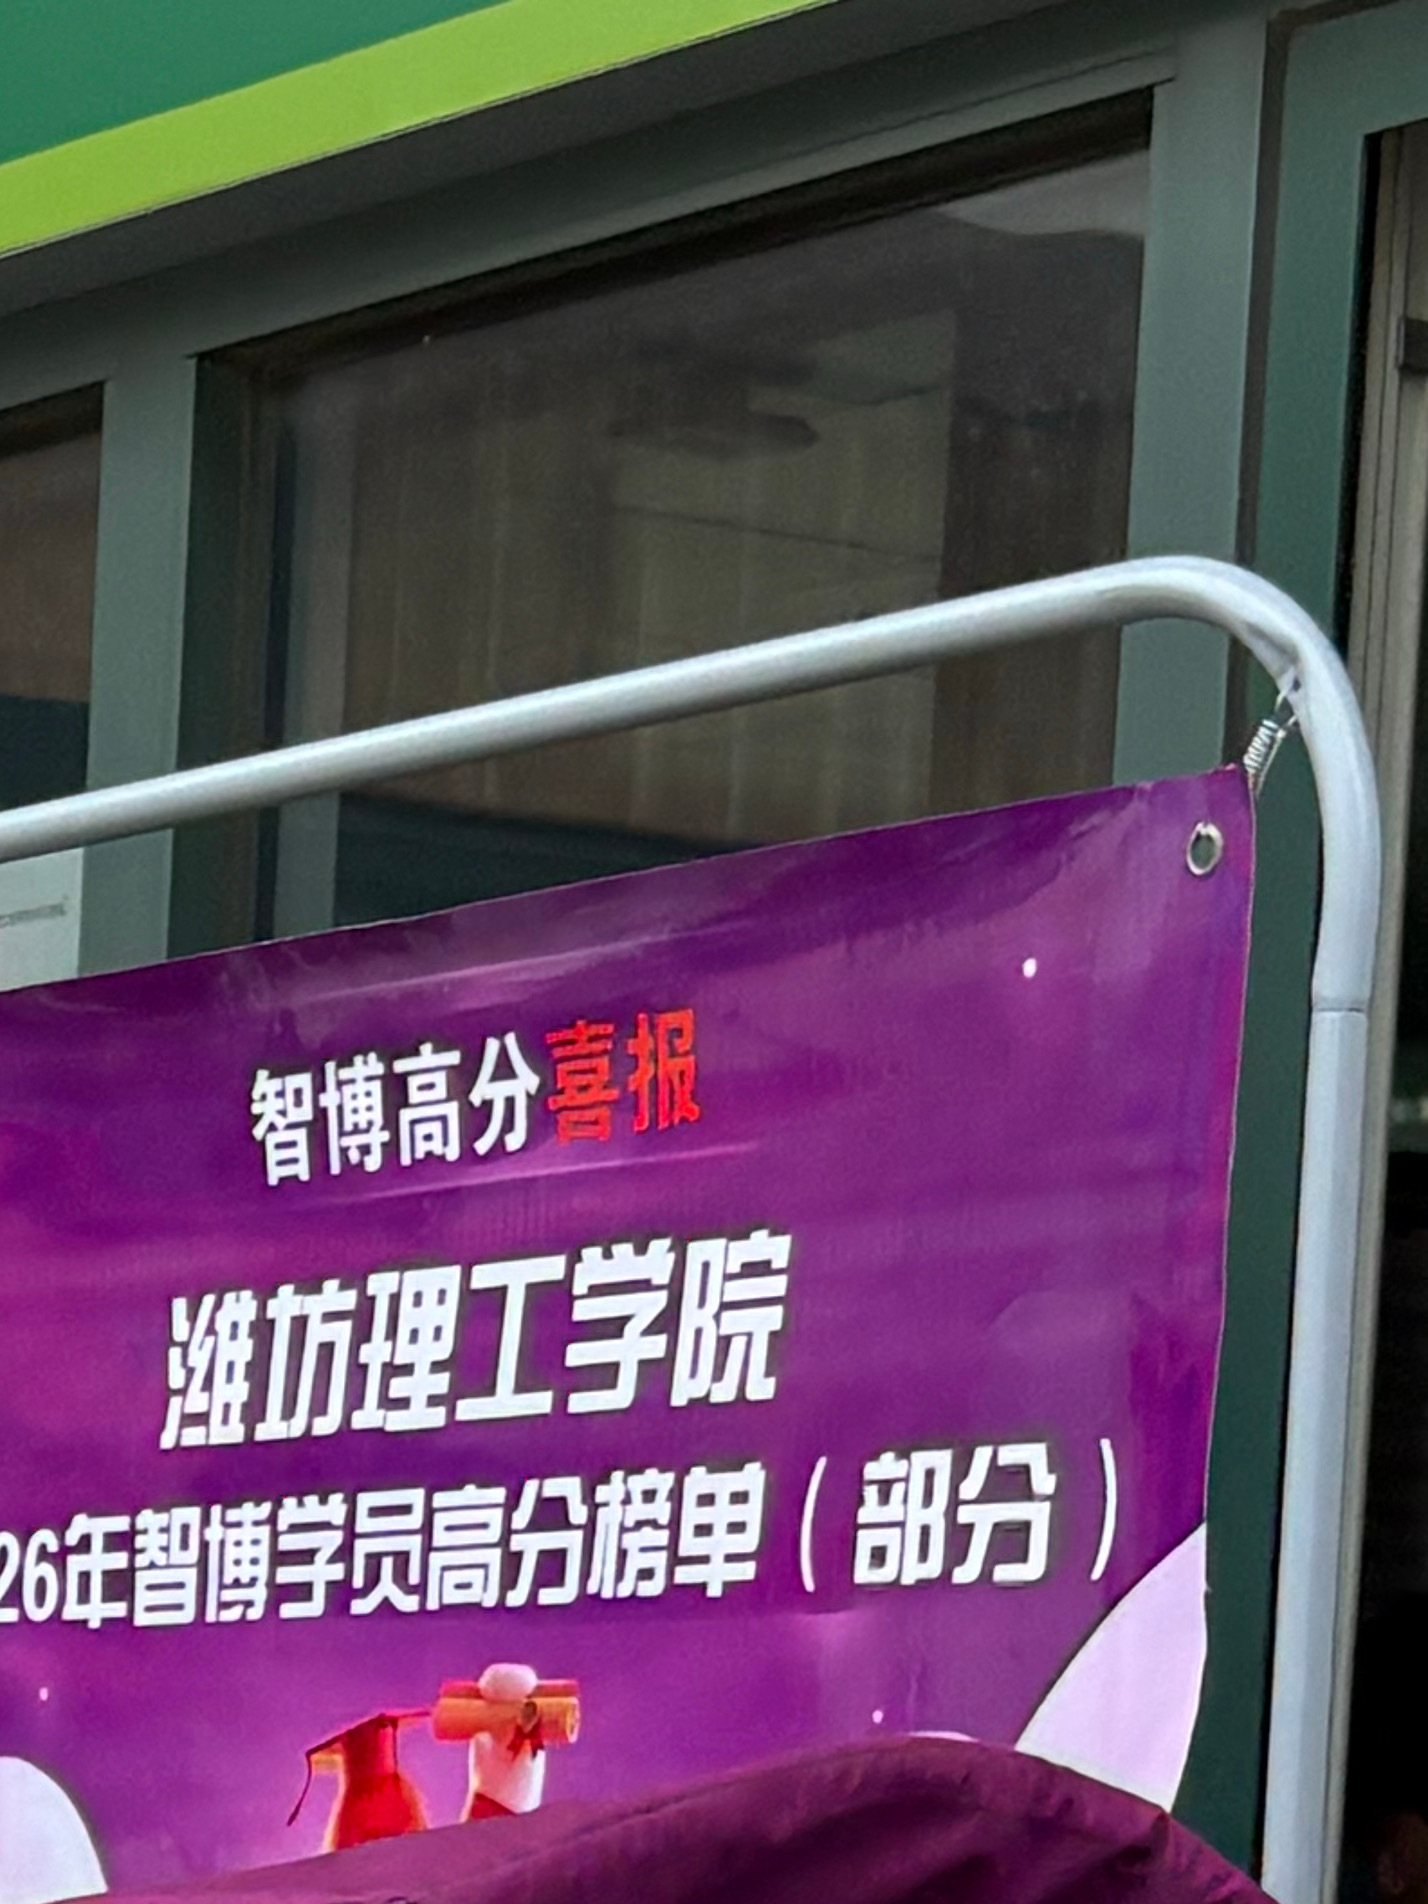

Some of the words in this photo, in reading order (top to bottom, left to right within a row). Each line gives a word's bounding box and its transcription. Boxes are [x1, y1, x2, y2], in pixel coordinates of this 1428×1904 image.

[250, 1008, 699, 1187] 智博高分喜报
[158, 1230, 794, 1453] 潍坊理工学院
